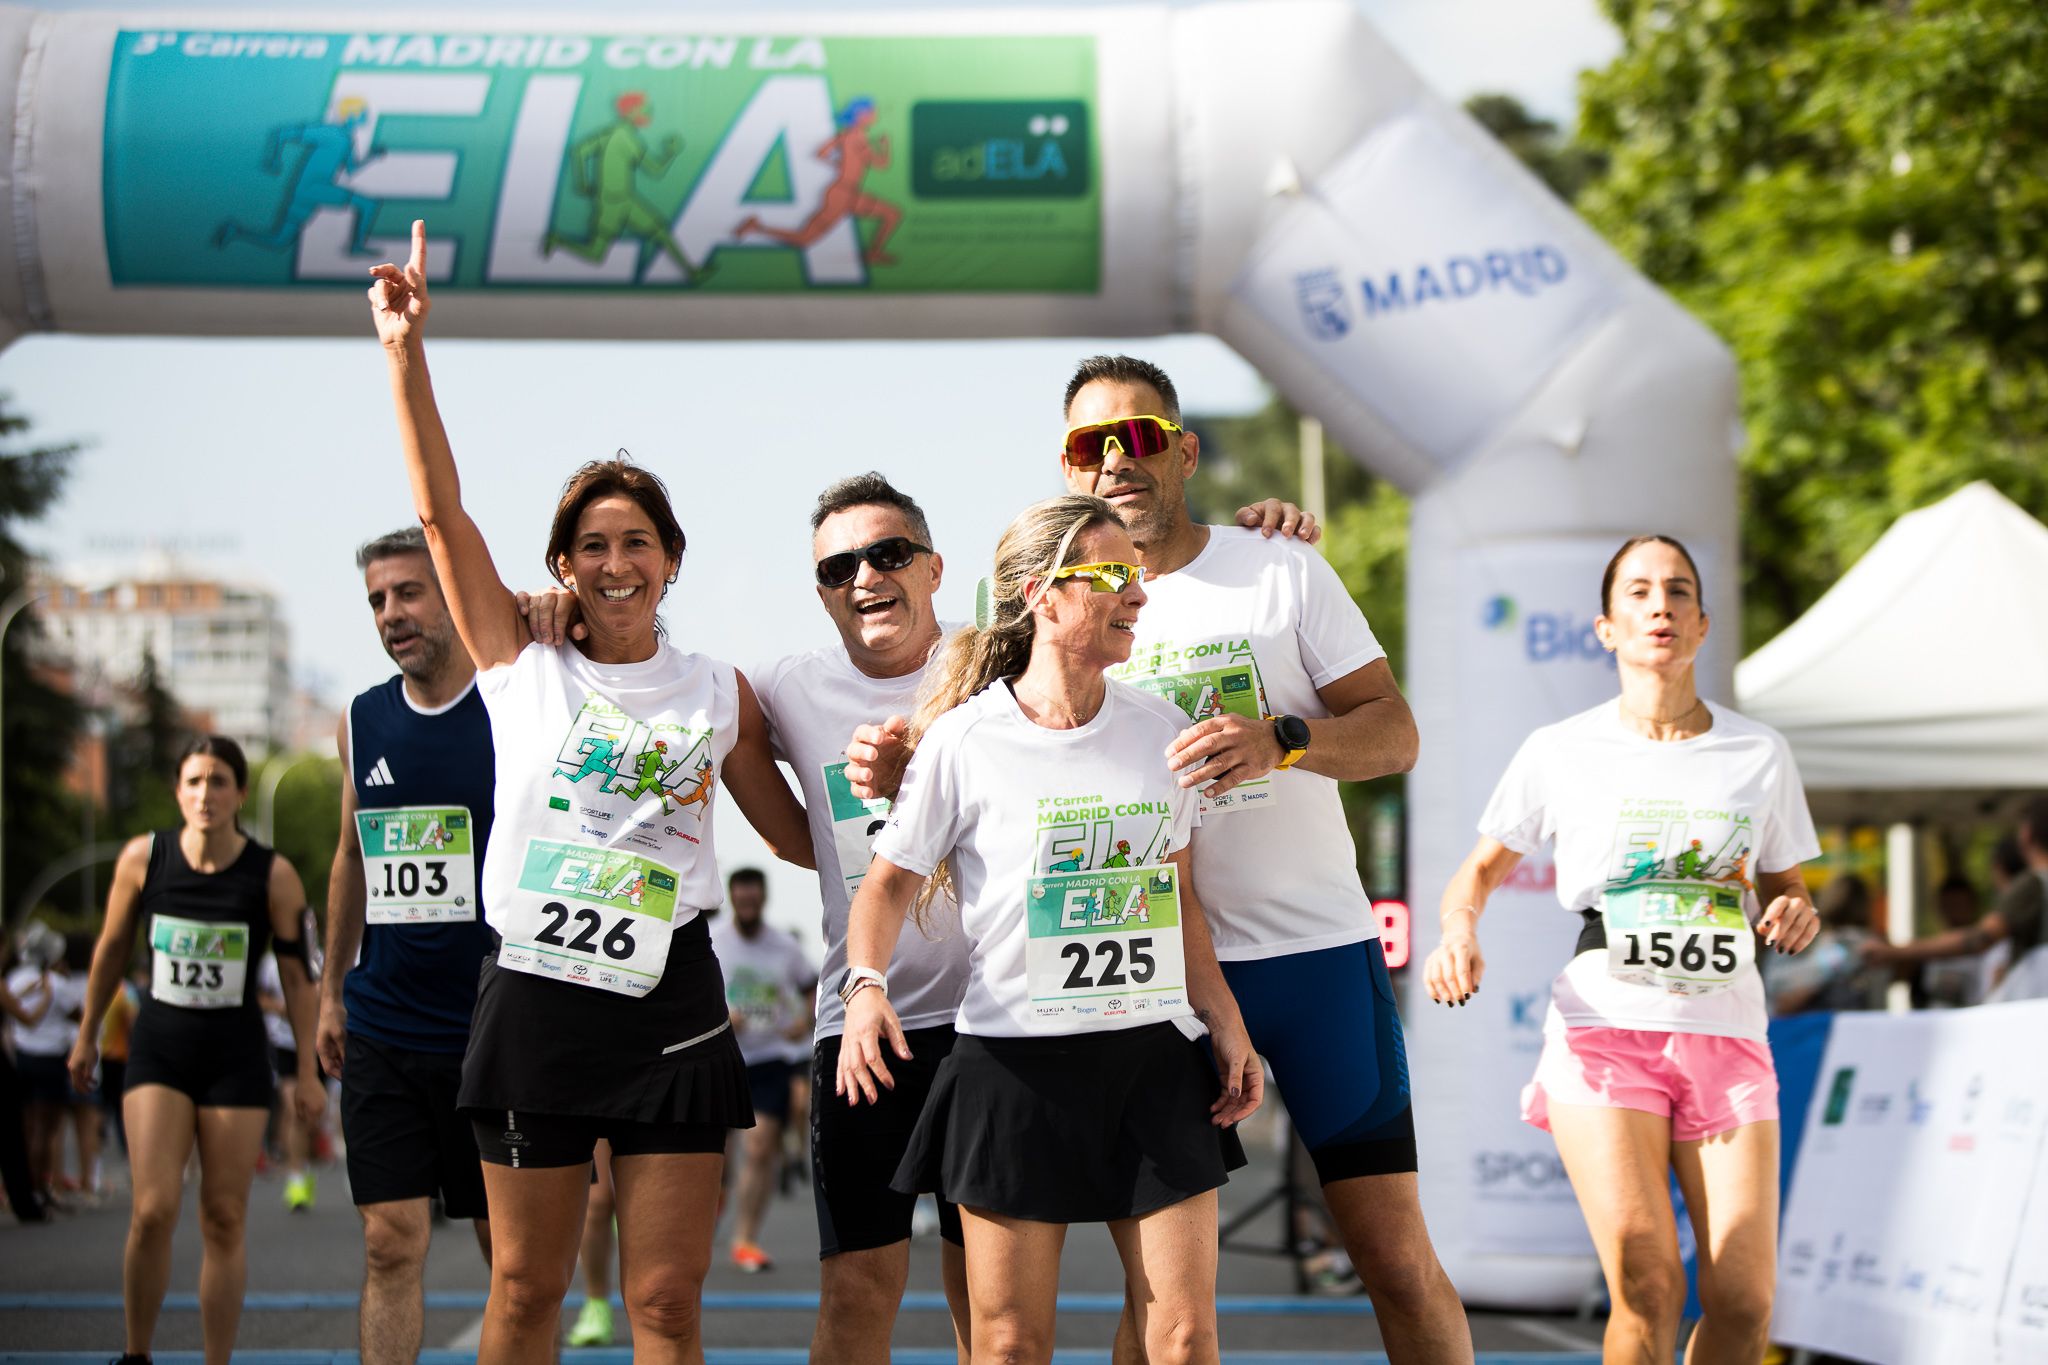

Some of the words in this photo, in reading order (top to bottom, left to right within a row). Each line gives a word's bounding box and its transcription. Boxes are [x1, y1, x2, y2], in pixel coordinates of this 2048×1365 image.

[182, 34, 330, 60] Carrera
[341, 35, 592, 67] MADRID
[603, 37, 738, 69] CON
[747, 37, 829, 69] LA
[932, 138, 1068, 182] adELA
[292, 71, 870, 286] ELA
[1360, 245, 1569, 318] MADRID
[1184, 642, 1223, 660] CON
[1227, 638, 1251, 653] LA
[1526, 612, 1617, 668] Bio
[1176, 678, 1198, 687] CON
[1200, 675, 1212, 684] LA
[654, 723, 691, 736] CON
[1054, 793, 1103, 807] Carrera
[1215, 799, 1229, 807] LIFE
[1247, 792, 1269, 801] MADRID
[410, 812, 428, 821] CON
[428, 812, 439, 821] LA
[1037, 806, 1111, 825] MADRID
[1114, 802, 1153, 817] CON
[1619, 809, 1688, 819] MADRID
[1693, 809, 1730, 821] CON
[384, 820, 445, 852] ELA
[586, 828, 608, 840] MADRID
[566, 848, 607, 863] MADRID
[607, 855, 629, 866] CON
[1607, 820, 1753, 883] ELA
[383, 861, 449, 898] 103
[550, 857, 644, 907] ELA
[1066, 877, 1107, 889] MADRID
[1108, 876, 1128, 886] CON
[1130, 874, 1141, 884] LA
[1059, 884, 1150, 929] ELA
[1638, 893, 1718, 924] ELA
[170, 927, 225, 957] ELA
[533, 901, 637, 961] 226
[1060, 936, 1156, 990] 225
[1623, 931, 1738, 974] 1565
[169, 960, 224, 990] 123
[599, 976, 612, 984] LIFE
[631, 981, 653, 992] MADRID
[1077, 1006, 1097, 1015] Biogen
[1163, 998, 1182, 1006] MADRID
